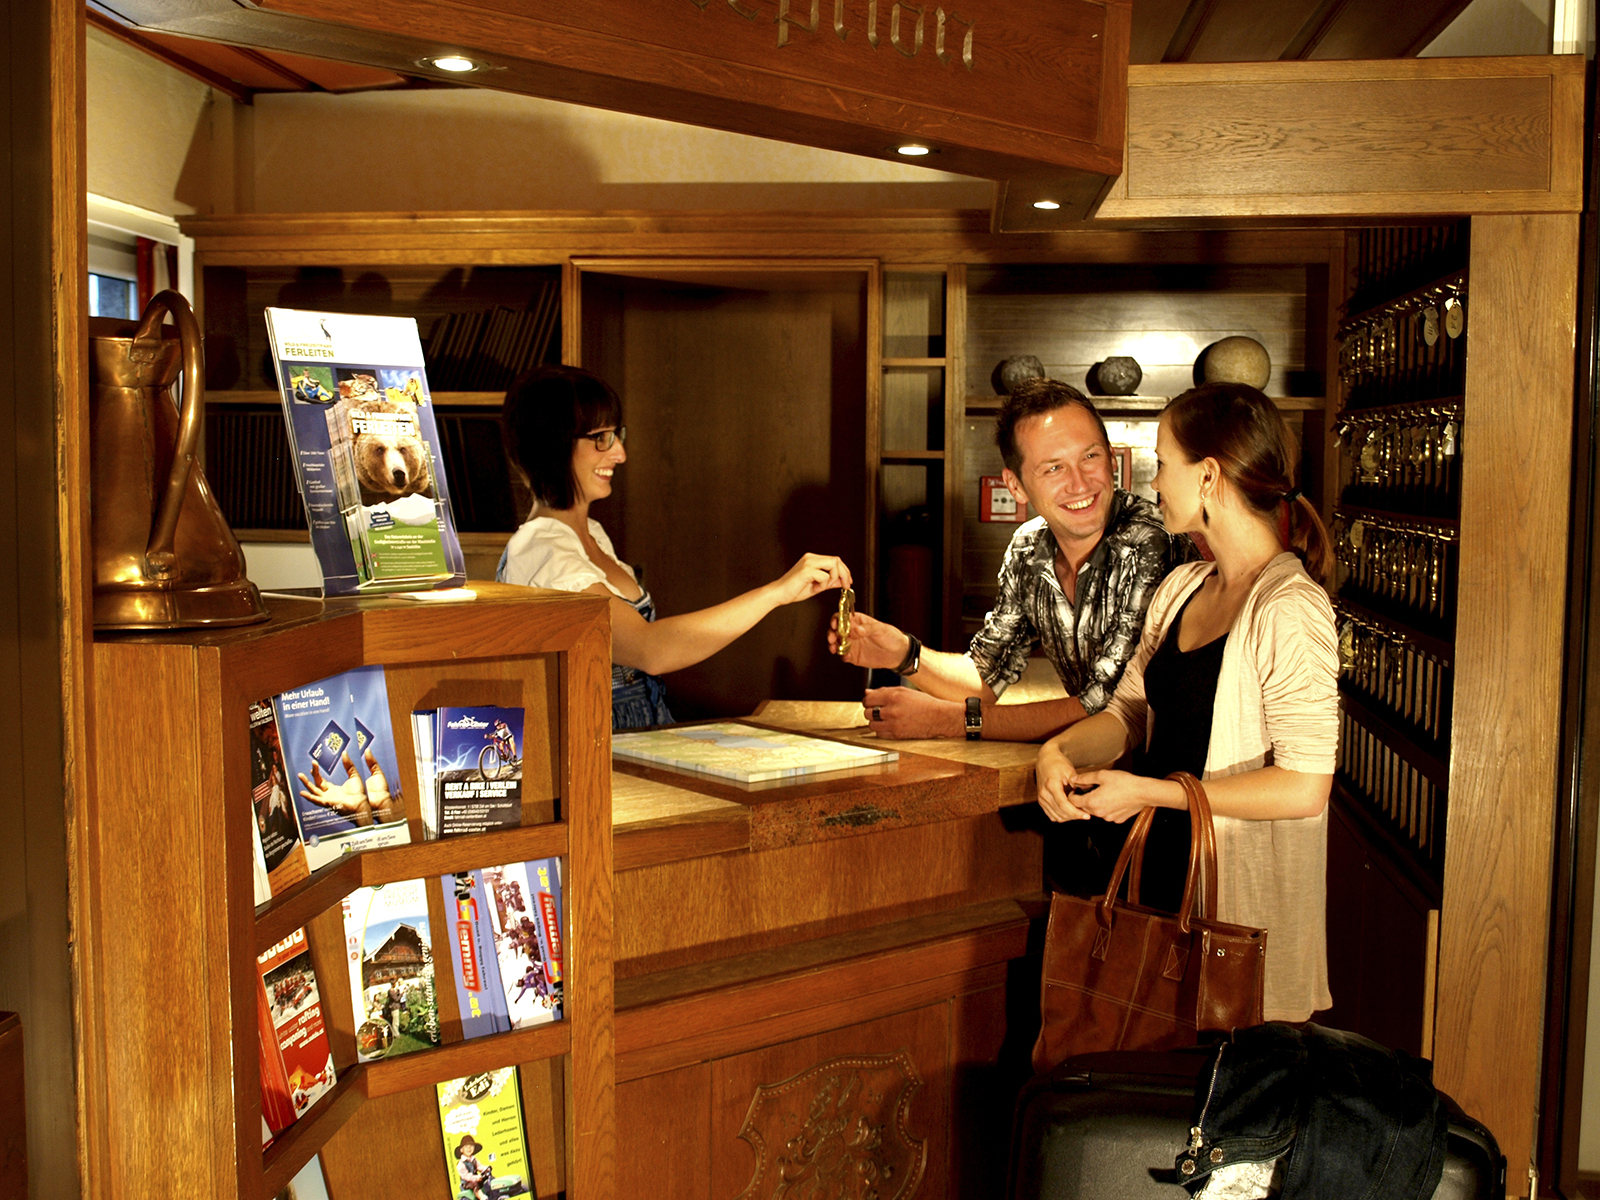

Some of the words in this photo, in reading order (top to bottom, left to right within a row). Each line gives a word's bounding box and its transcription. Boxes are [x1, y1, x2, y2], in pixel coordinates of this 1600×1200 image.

[285, 348, 334, 358] FERLEITEN
[352, 420, 416, 436] FERLEITEN
[282, 691, 300, 701] Mehr
[300, 688, 324, 698] Urlaub
[283, 702, 290, 711] in
[291, 700, 308, 710] einer
[309, 696, 330, 708] Hand!
[445, 782, 463, 790] RENT
[463, 782, 469, 790] A
[470, 782, 486, 790] BIKE
[490, 781, 517, 789] VERLEIH
[444, 790, 475, 799] VERKAUF
[480, 789, 507, 798] SERVICE
[384, 896, 419, 908] MUSEUM
[298, 1007, 320, 1026] rafting
[470, 1078, 490, 1098] Edi
[483, 1108, 498, 1116] Kinder,
[500, 1104, 514, 1112] Damen
[492, 1125, 518, 1136] Lederhosen
